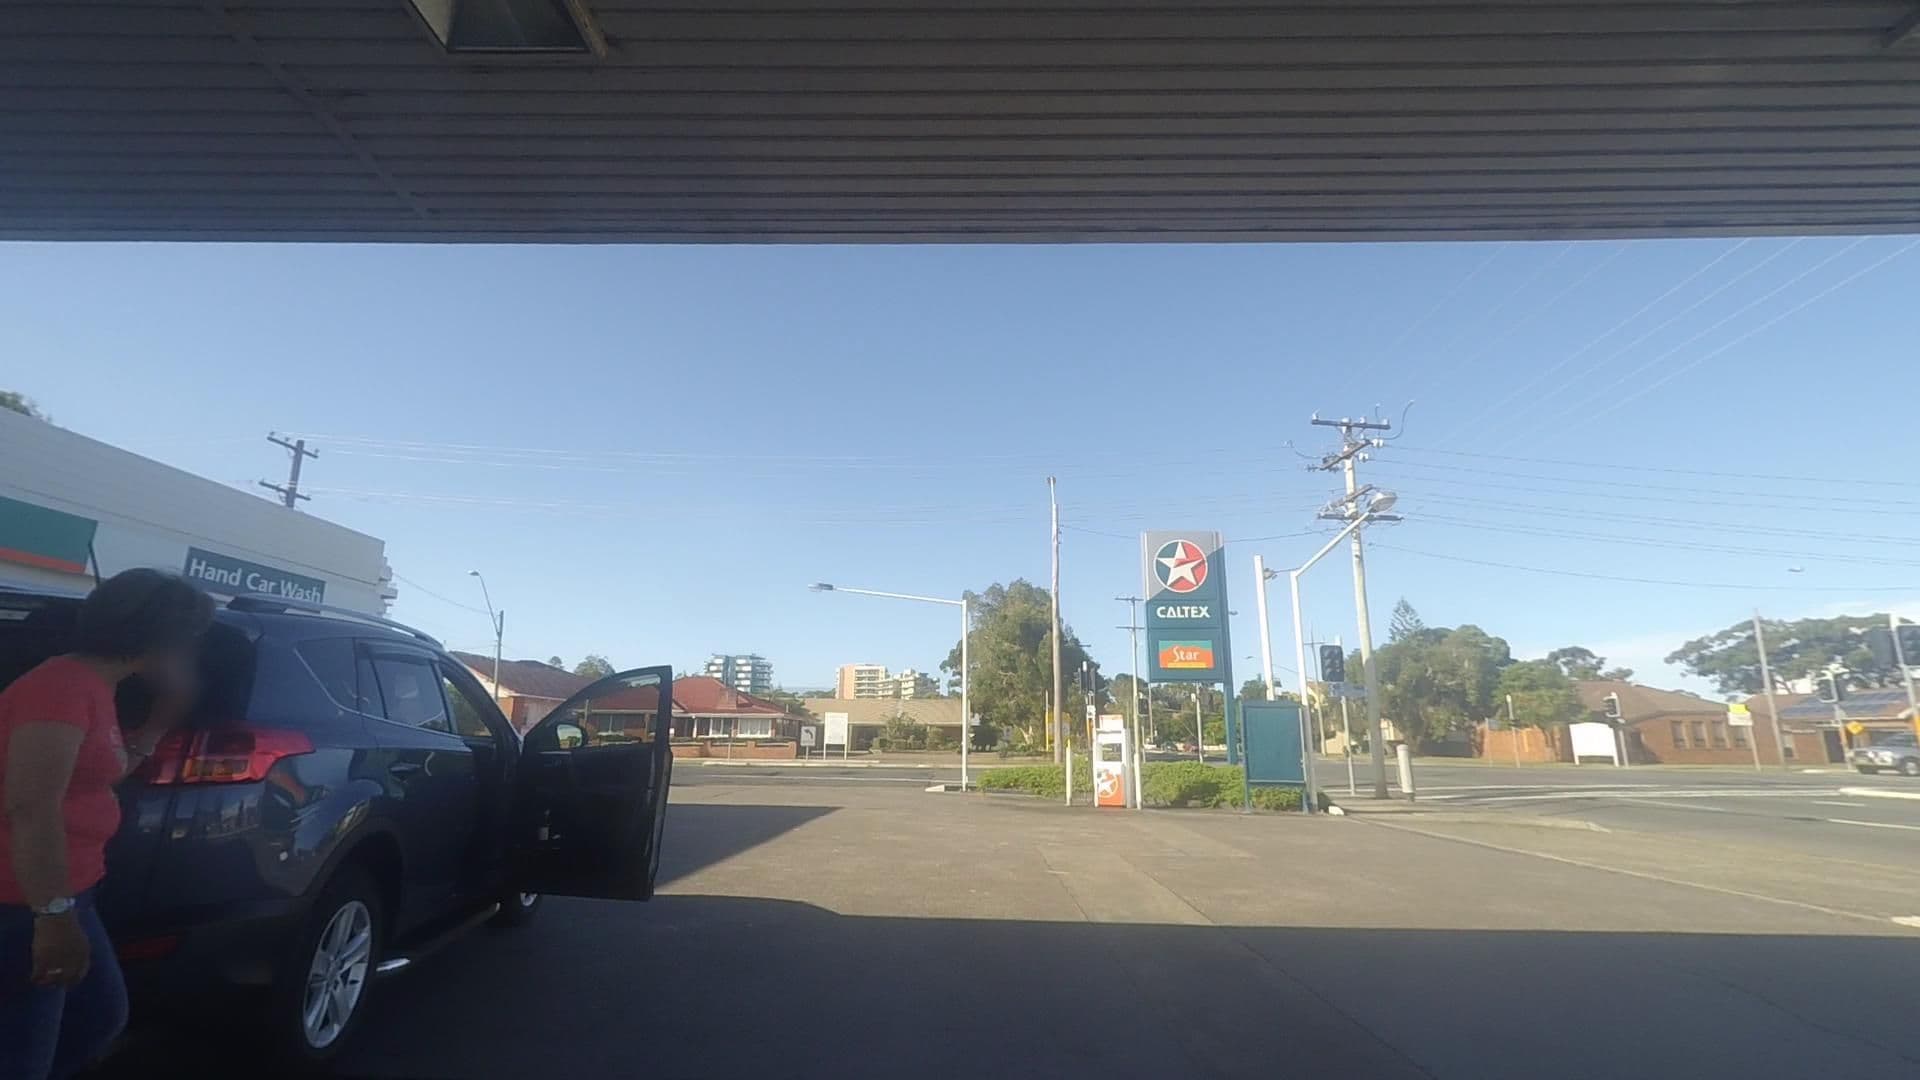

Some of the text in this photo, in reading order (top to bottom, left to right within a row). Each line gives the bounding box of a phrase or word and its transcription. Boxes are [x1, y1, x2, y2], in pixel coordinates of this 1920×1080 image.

[190, 559, 321, 603] Hand Car Wash
[1156, 606, 1211, 618] CALTEX
[1172, 645, 1199, 662] Star
